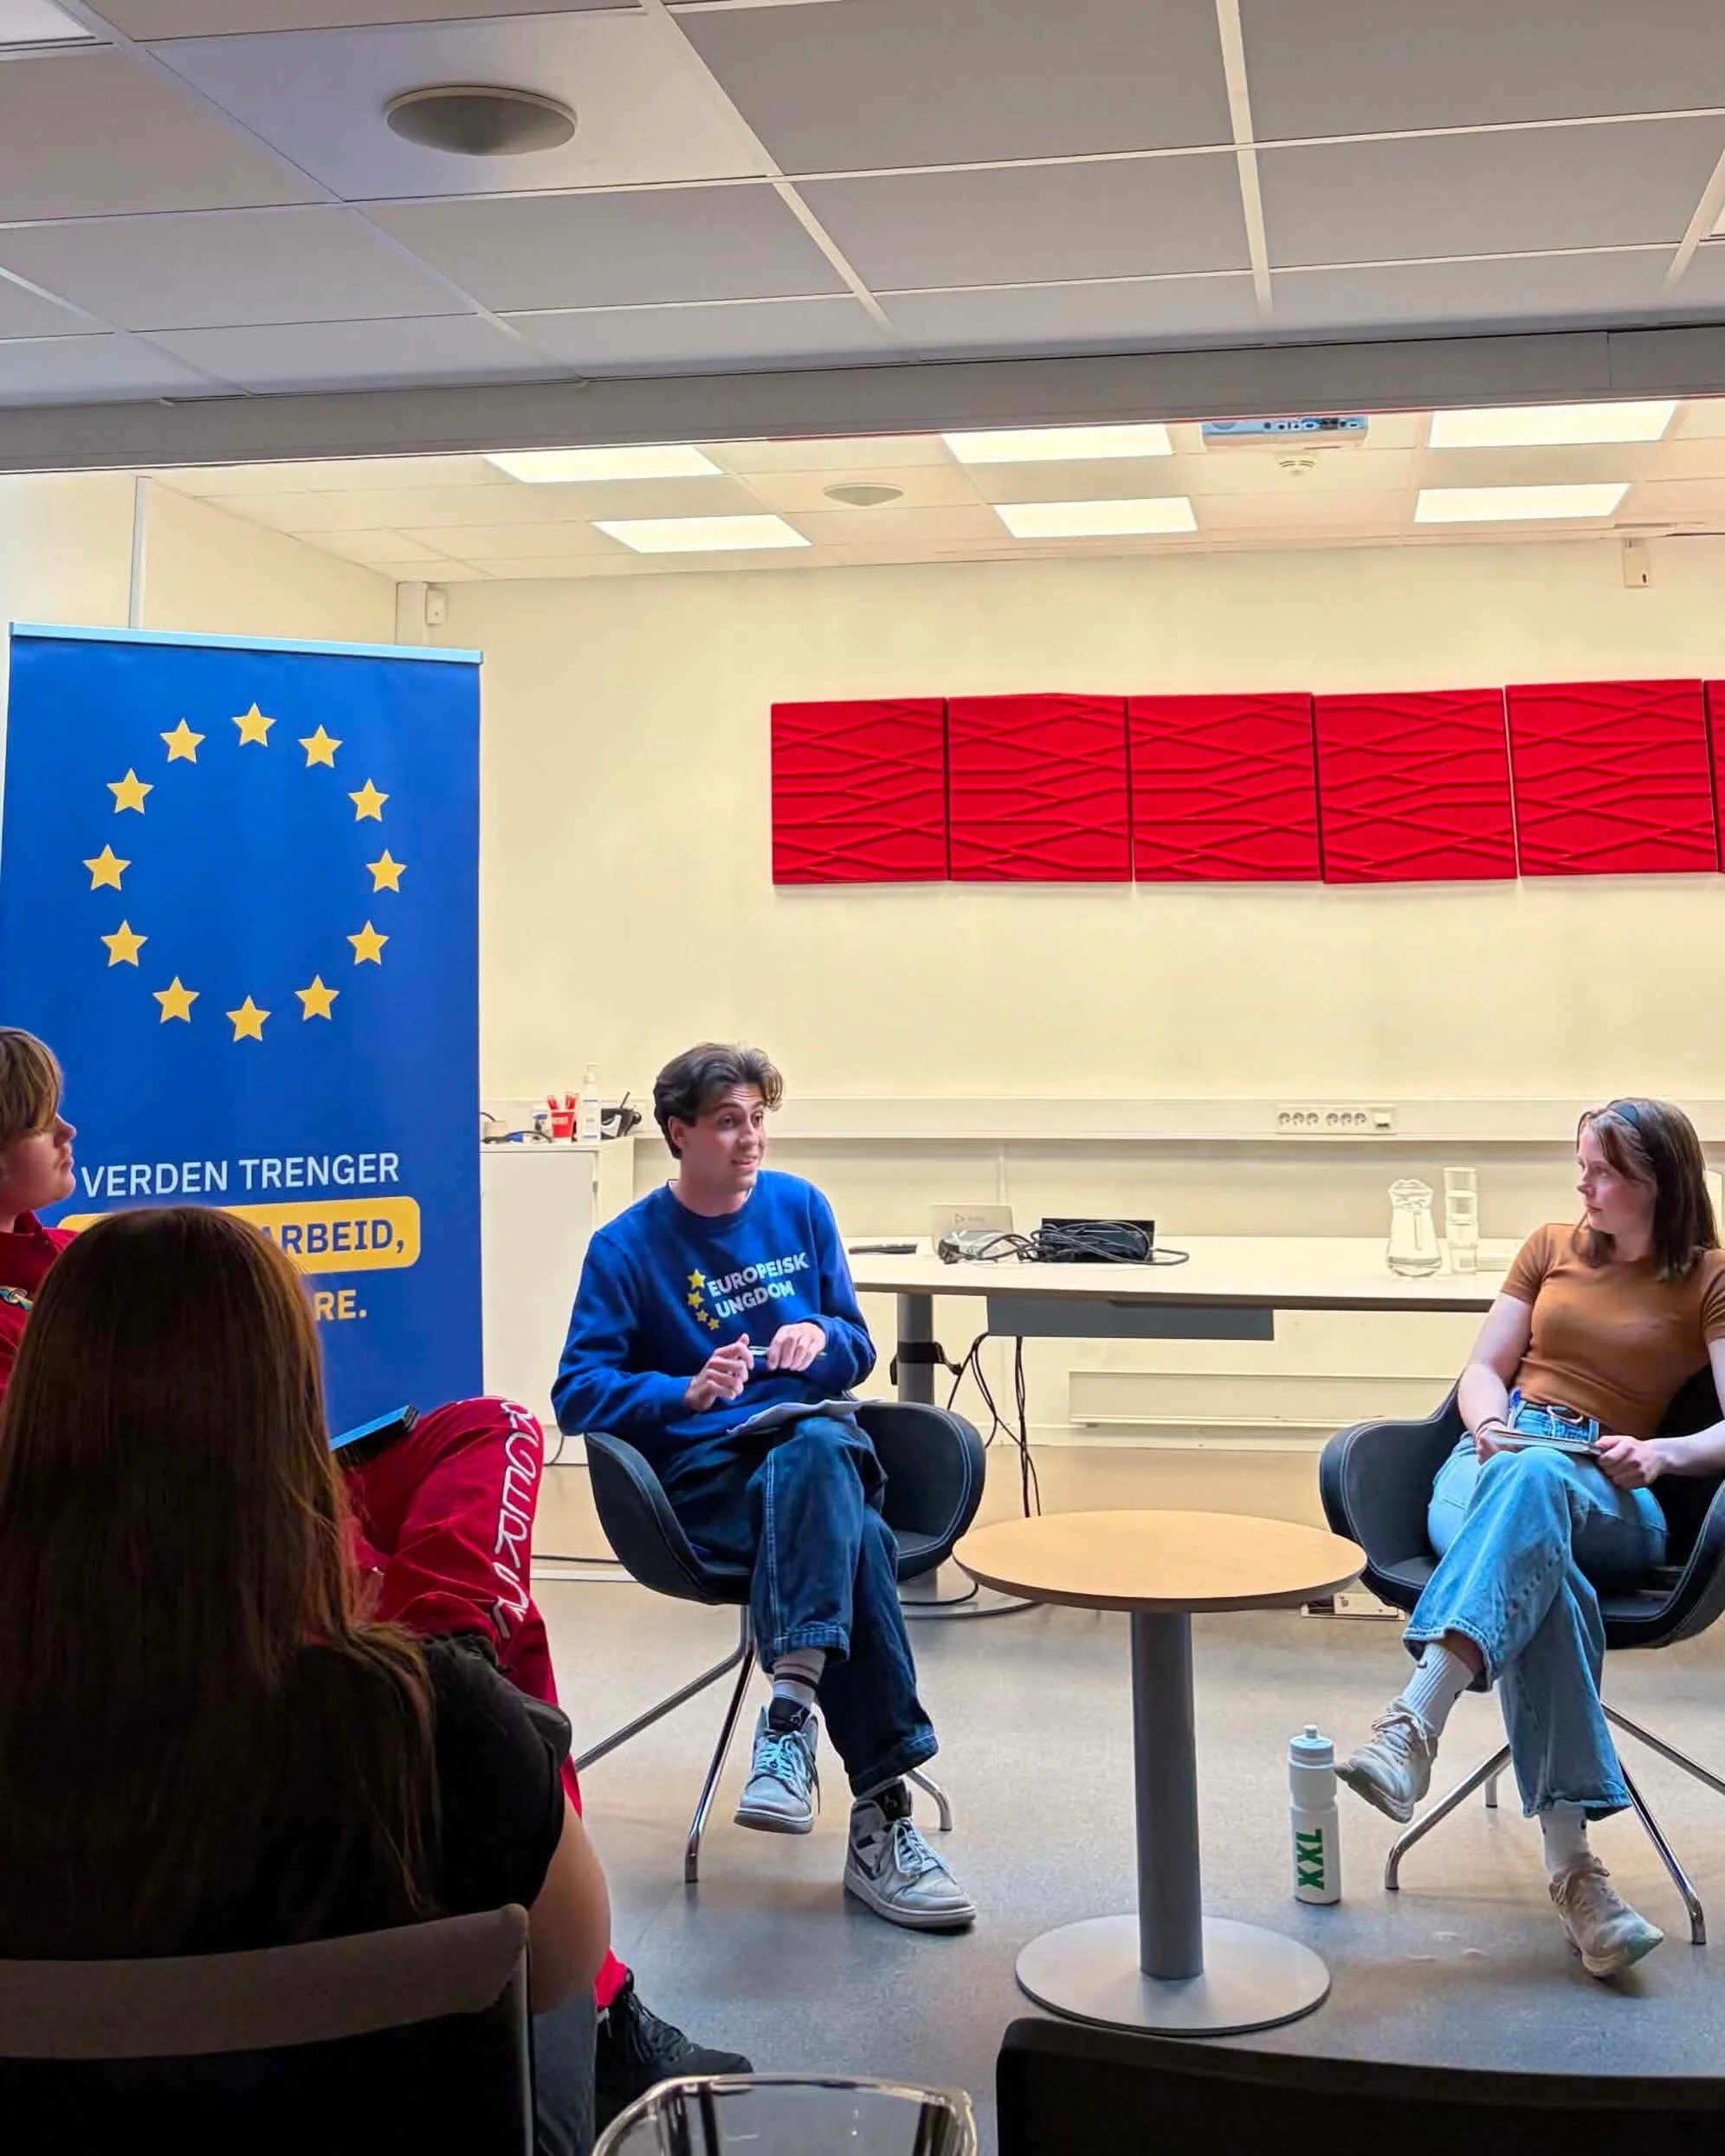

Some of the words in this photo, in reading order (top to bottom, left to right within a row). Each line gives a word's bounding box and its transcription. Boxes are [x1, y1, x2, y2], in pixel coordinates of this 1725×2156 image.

[81, 1160, 228, 1197] VERDEN
[239, 1152, 399, 1189] TRENGER
[707, 1253, 810, 1297] EUROPEISK
[714, 1280, 795, 1318] UNGDOM
[1295, 1829, 1325, 1890] XXL
